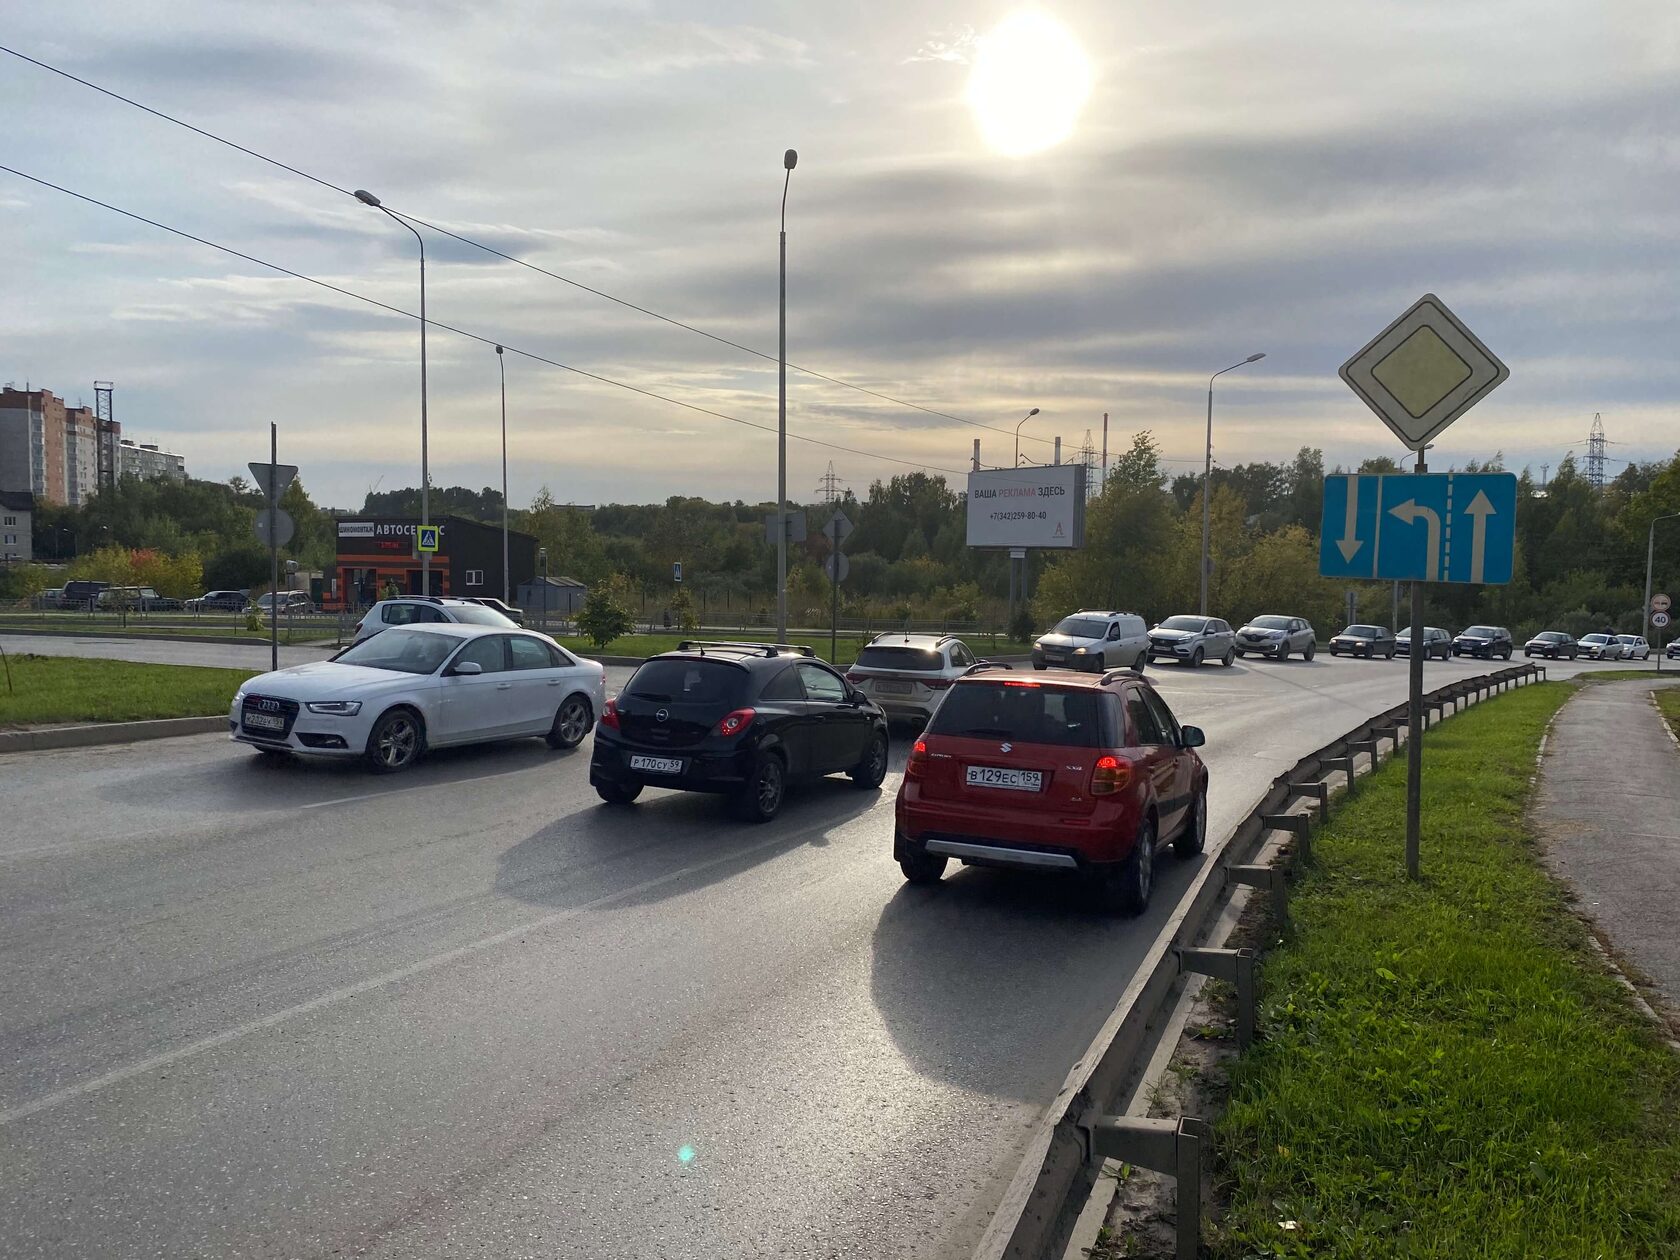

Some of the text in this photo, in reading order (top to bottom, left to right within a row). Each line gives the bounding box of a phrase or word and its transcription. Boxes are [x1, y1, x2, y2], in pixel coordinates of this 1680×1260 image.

[974, 486, 1065, 499] ВАША РЕКЛАМА ЗДЕСЬ
[990, 511, 1047, 521] +7(342)259-80-40
[376, 524, 445, 536] АВТОСЕС
[1654, 616, 1667, 624] 40
